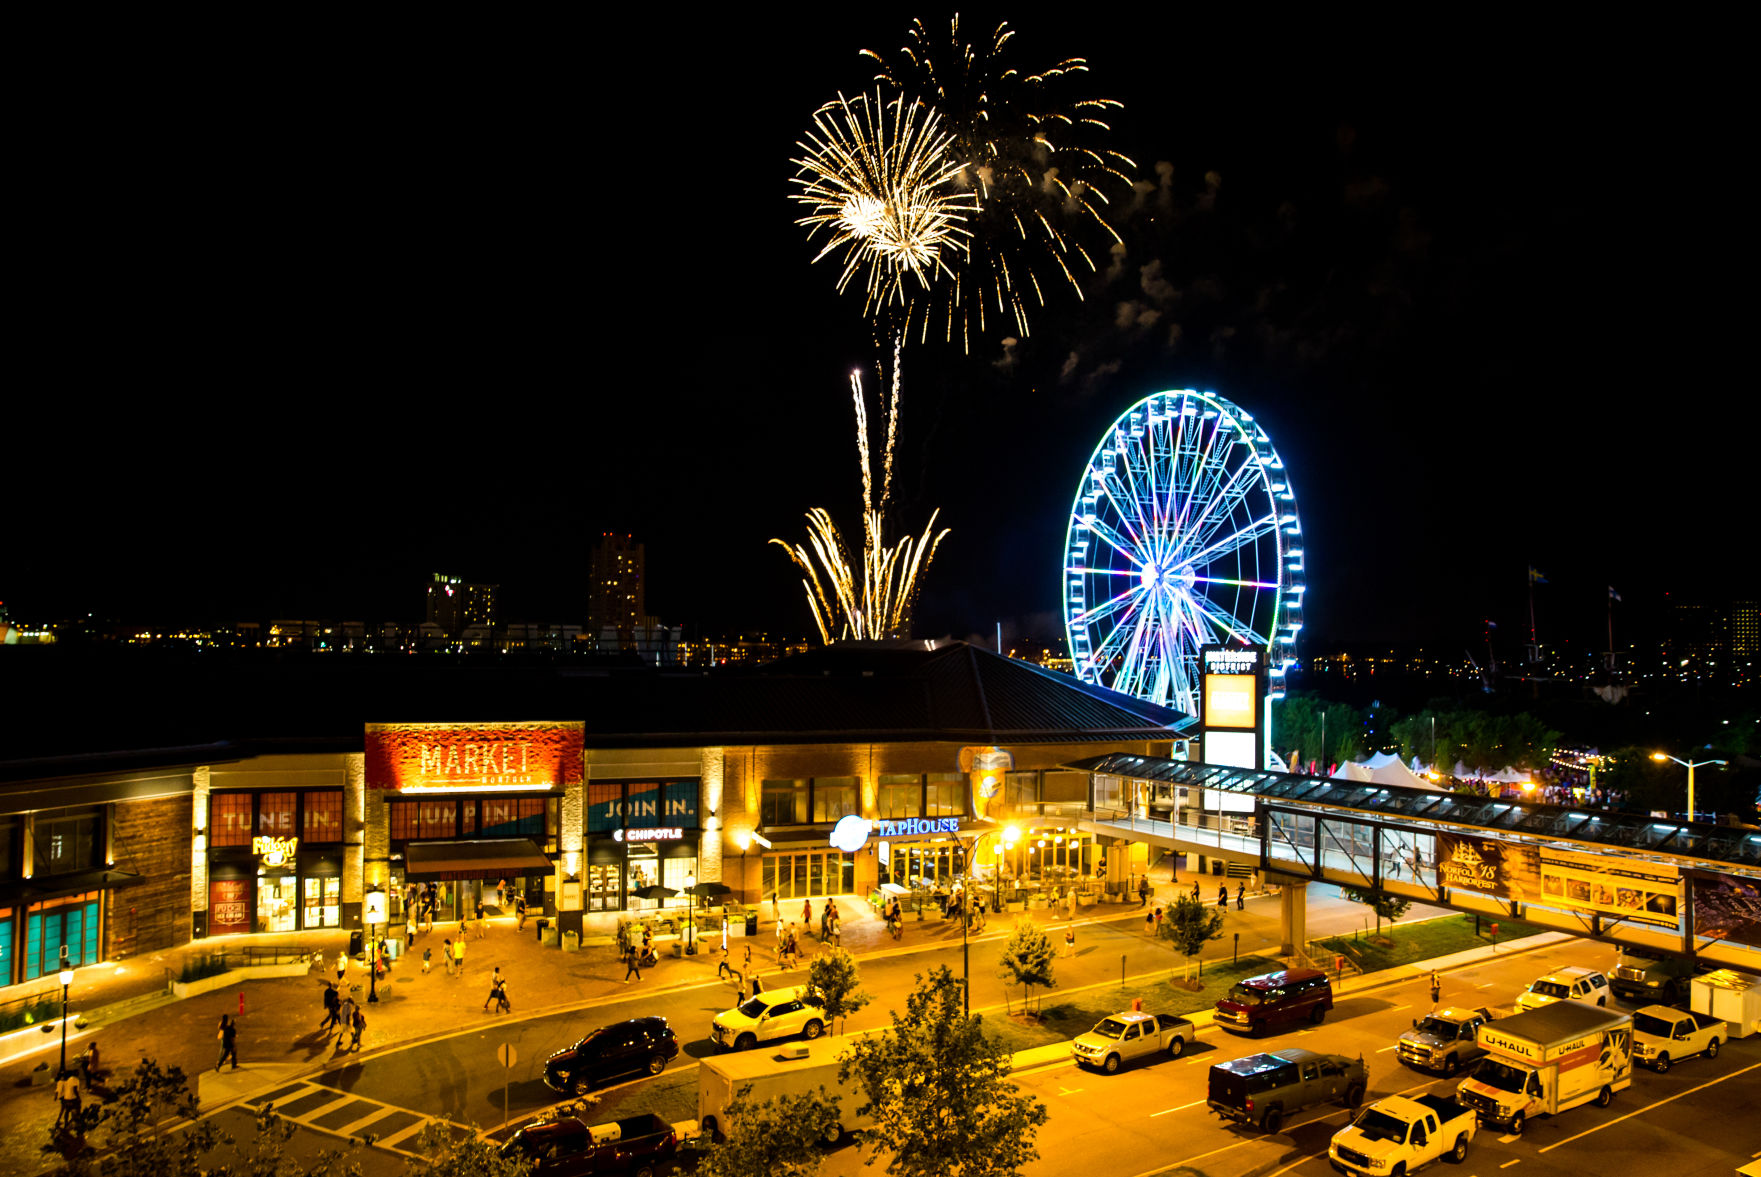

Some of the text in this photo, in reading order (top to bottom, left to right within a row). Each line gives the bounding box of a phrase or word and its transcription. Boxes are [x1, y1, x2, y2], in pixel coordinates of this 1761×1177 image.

[421, 744, 532, 775] MARKET
[412, 803, 517, 825] JUMP IN.
[604, 798, 694, 818] JOIN IN.
[223, 809, 339, 831] TUNE IN.
[879, 818, 959, 836] TAPHOUSE
[627, 829, 682, 840] CHIPOTLE
[1486, 1035, 1532, 1056] U-HAUL
[1559, 1040, 1585, 1055] U-HAUL
